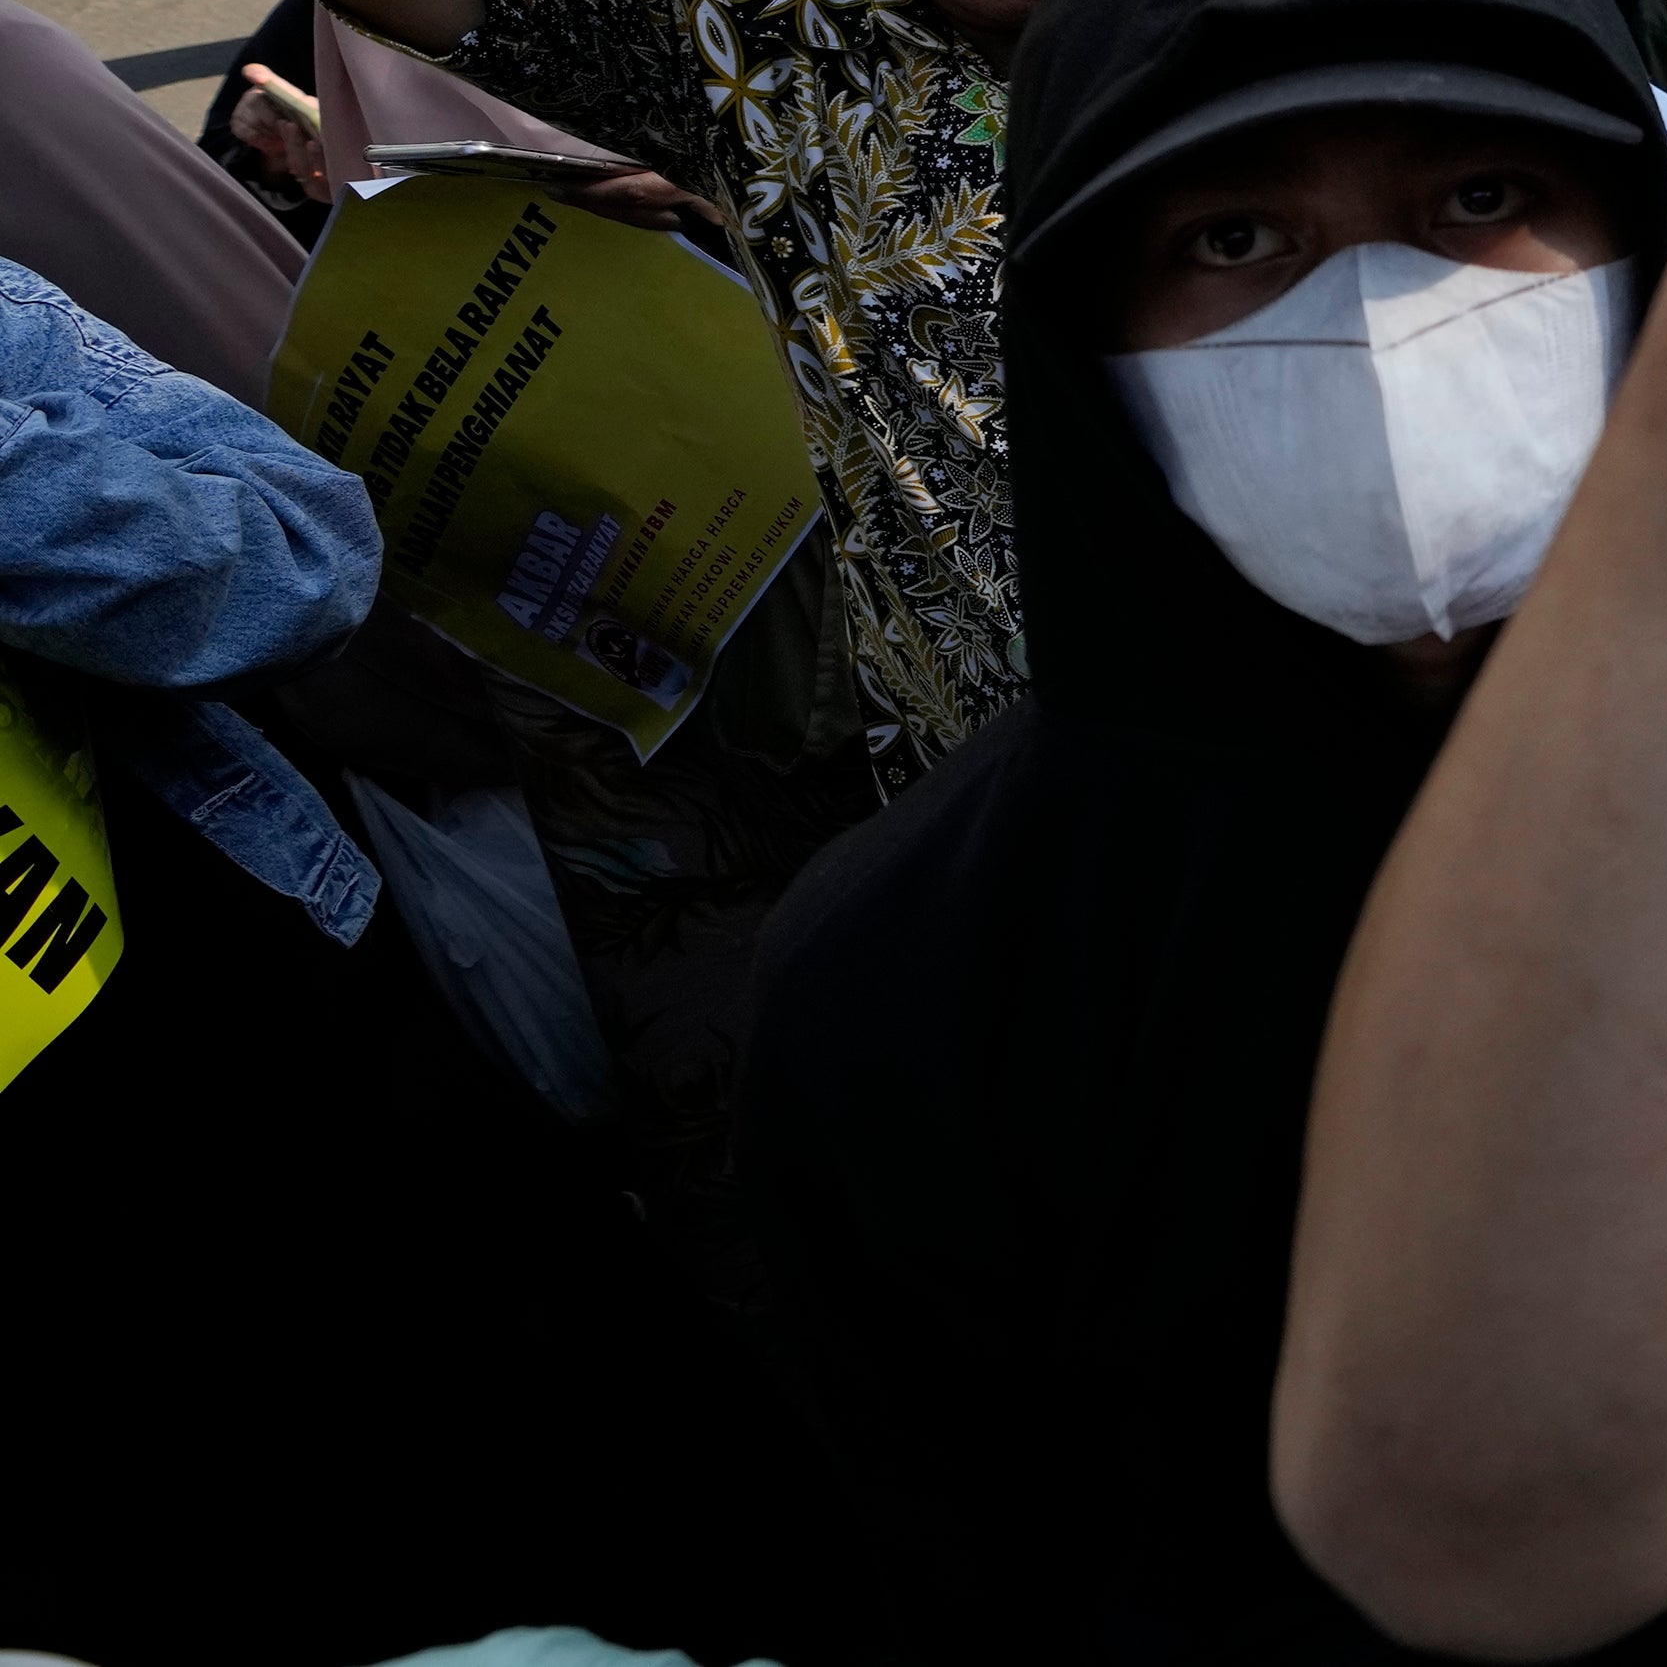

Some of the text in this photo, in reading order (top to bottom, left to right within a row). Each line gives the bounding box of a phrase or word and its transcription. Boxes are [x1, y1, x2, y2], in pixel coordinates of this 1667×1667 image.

[327, 330, 396, 433] RAYAT
[369, 389, 436, 479] TIDAK
[413, 327, 480, 405] BELA
[456, 202, 557, 336] RAKYAT
[394, 304, 563, 577] ADALAH PENGHIANAT
[494, 508, 582, 631] AKBAR
[640, 498, 678, 542] BBM
[671, 539, 711, 586] HARGA
[706, 488, 747, 537] HARGA
[692, 545, 738, 601] JOKOWI
[707, 547, 768, 624] SUPREMASI
[763, 496, 804, 547] HUKUM
[0, 804, 109, 996] AN
